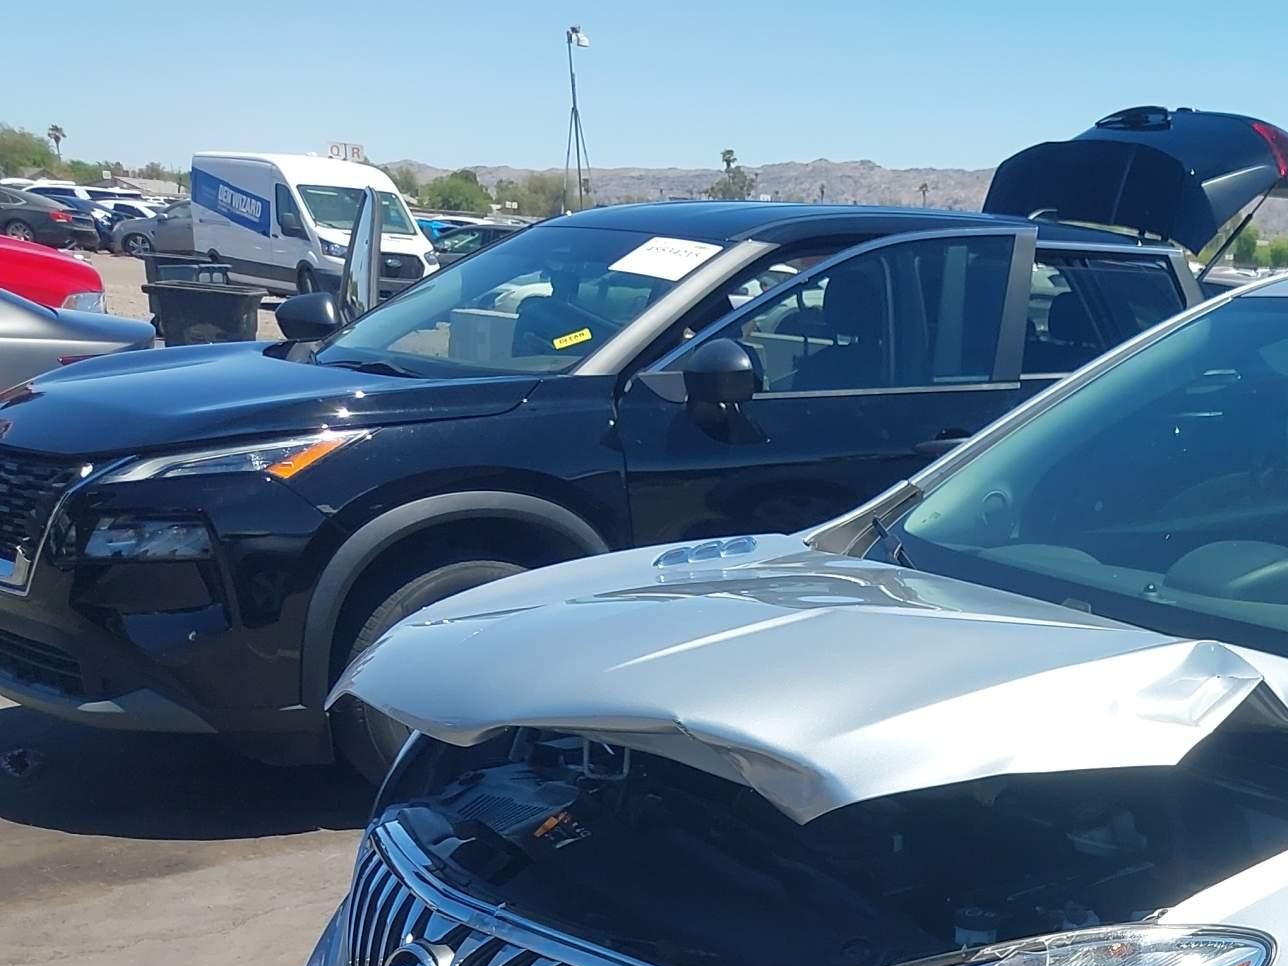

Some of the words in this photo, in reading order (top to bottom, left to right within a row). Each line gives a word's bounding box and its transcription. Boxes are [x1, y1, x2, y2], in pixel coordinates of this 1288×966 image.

[351, 146, 361, 160] R
[231, 191, 263, 219] WIZARD
[559, 332, 585, 344] CLEAN
